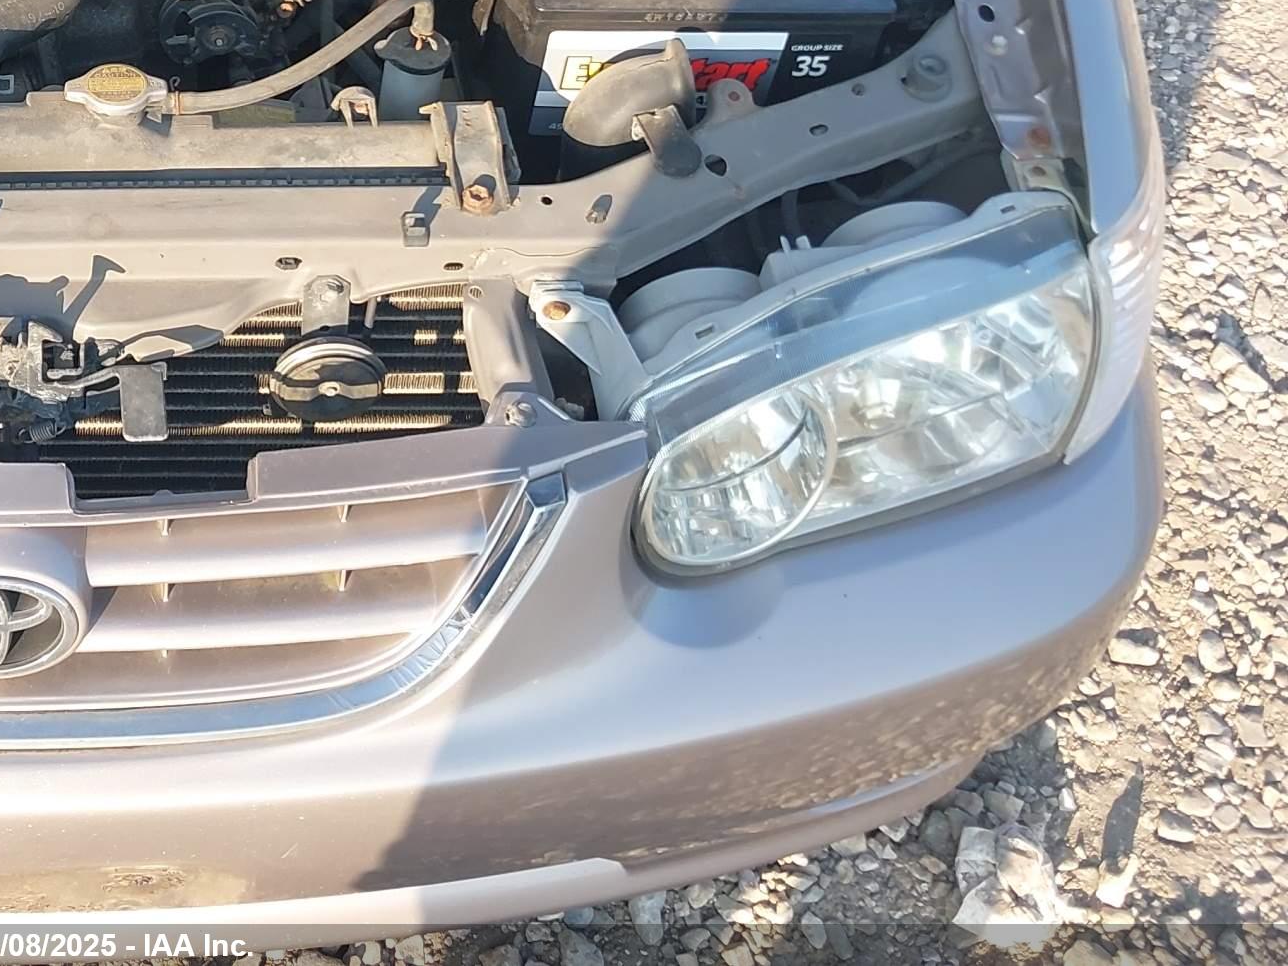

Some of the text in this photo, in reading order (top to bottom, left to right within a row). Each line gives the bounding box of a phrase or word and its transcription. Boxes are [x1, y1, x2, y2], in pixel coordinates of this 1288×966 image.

[791, 44, 843, 52] GROUP SIZE
[791, 55, 830, 77] 35
